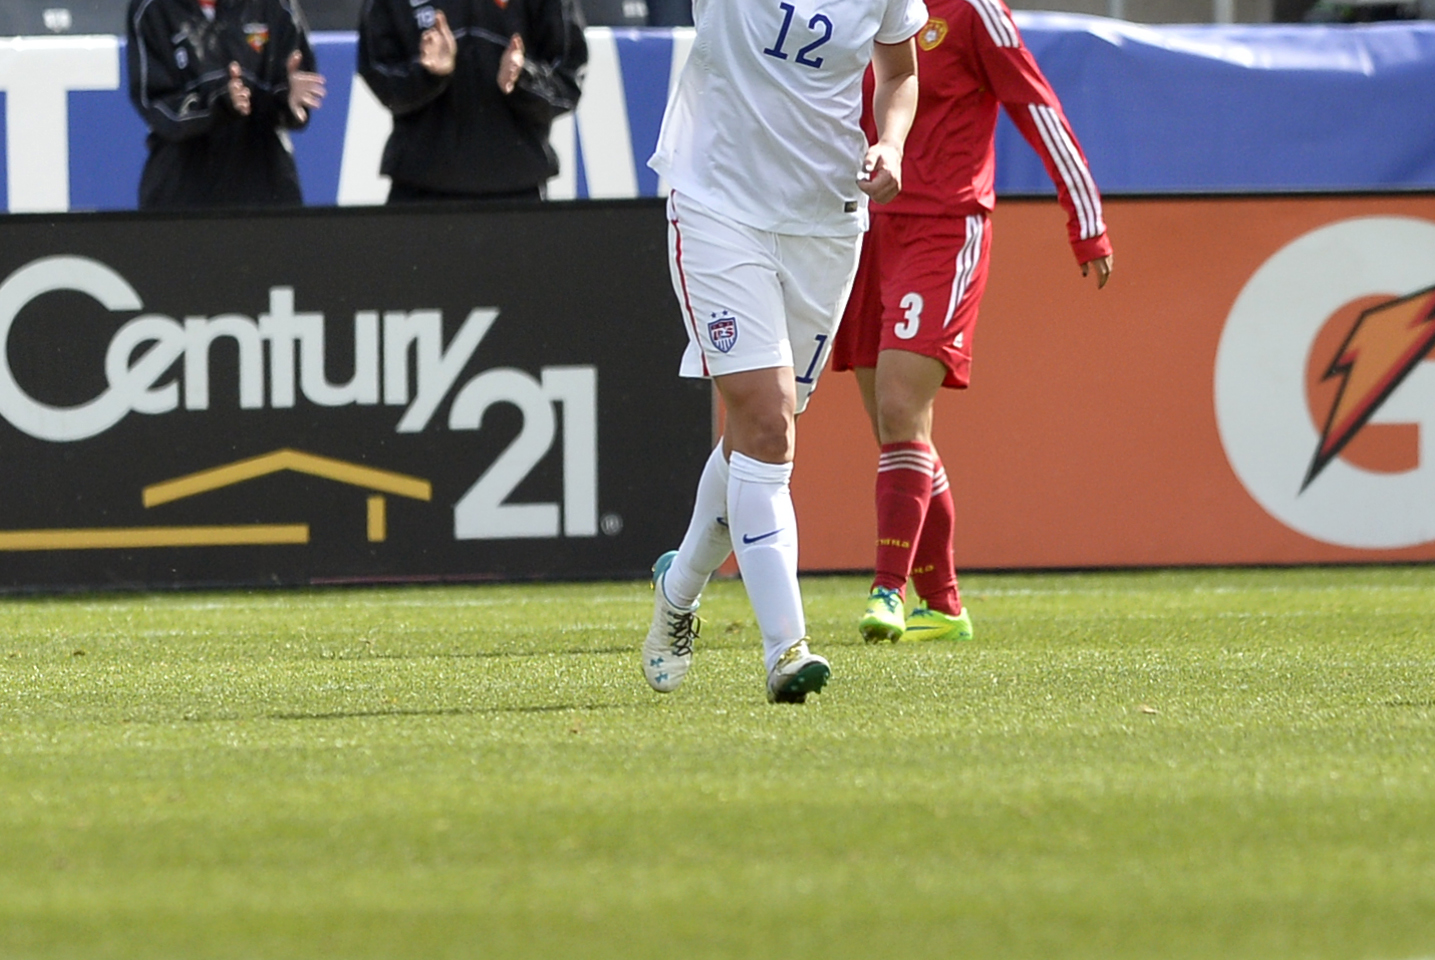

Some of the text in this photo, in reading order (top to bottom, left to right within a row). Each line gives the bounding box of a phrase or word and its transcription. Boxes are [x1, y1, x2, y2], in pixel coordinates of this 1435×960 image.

[763, 2, 833, 68] 12
[894, 292, 924, 339] 3
[0, 254, 598, 540] Century 21
